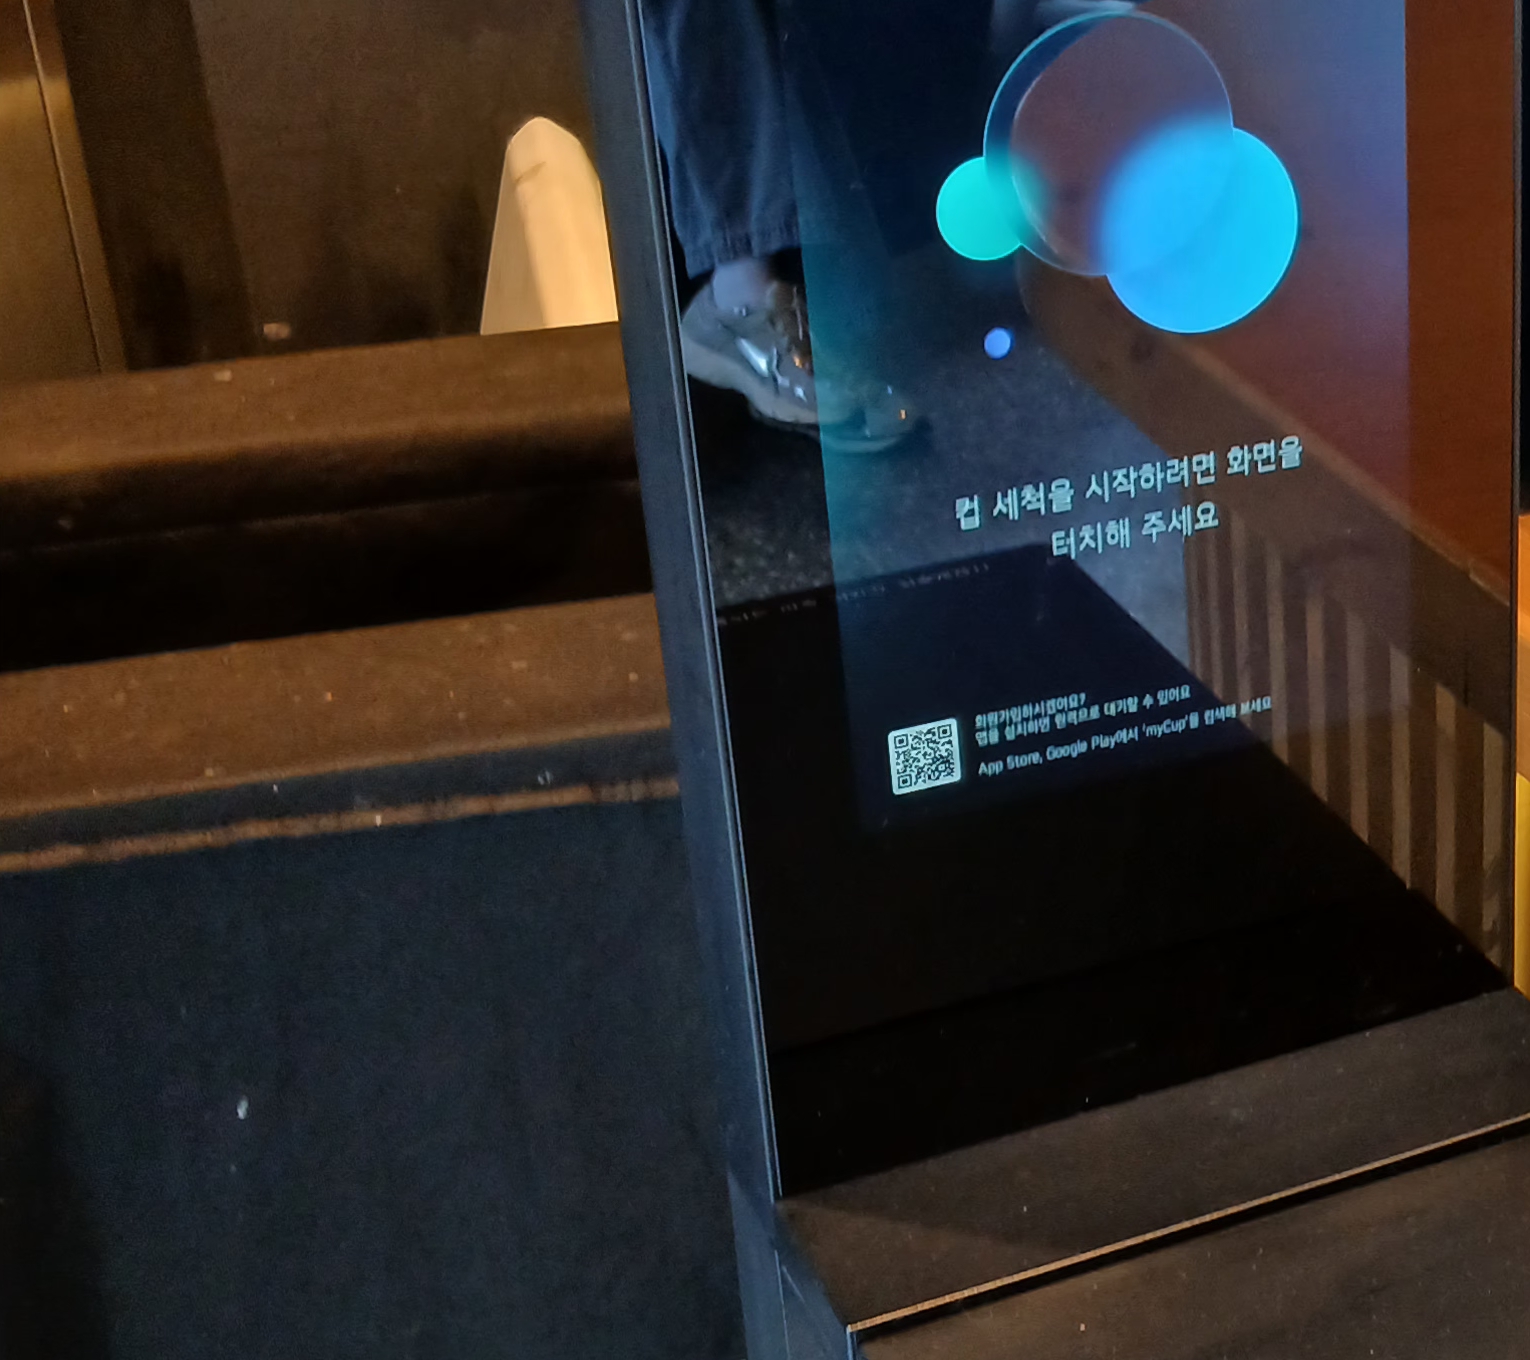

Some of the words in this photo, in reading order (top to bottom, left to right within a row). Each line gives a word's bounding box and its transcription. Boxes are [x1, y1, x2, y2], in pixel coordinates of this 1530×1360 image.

[955, 495, 980, 531] 컵
[992, 478, 1074, 522] 세척을
[1085, 451, 1217, 502] 시작하려면
[1226, 435, 1303, 477] 화면을
[1052, 516, 1131, 560] 터치해
[1142, 501, 1219, 544] 주세요
[978, 761, 1004, 777] App
[1046, 739, 1088, 760] Google
